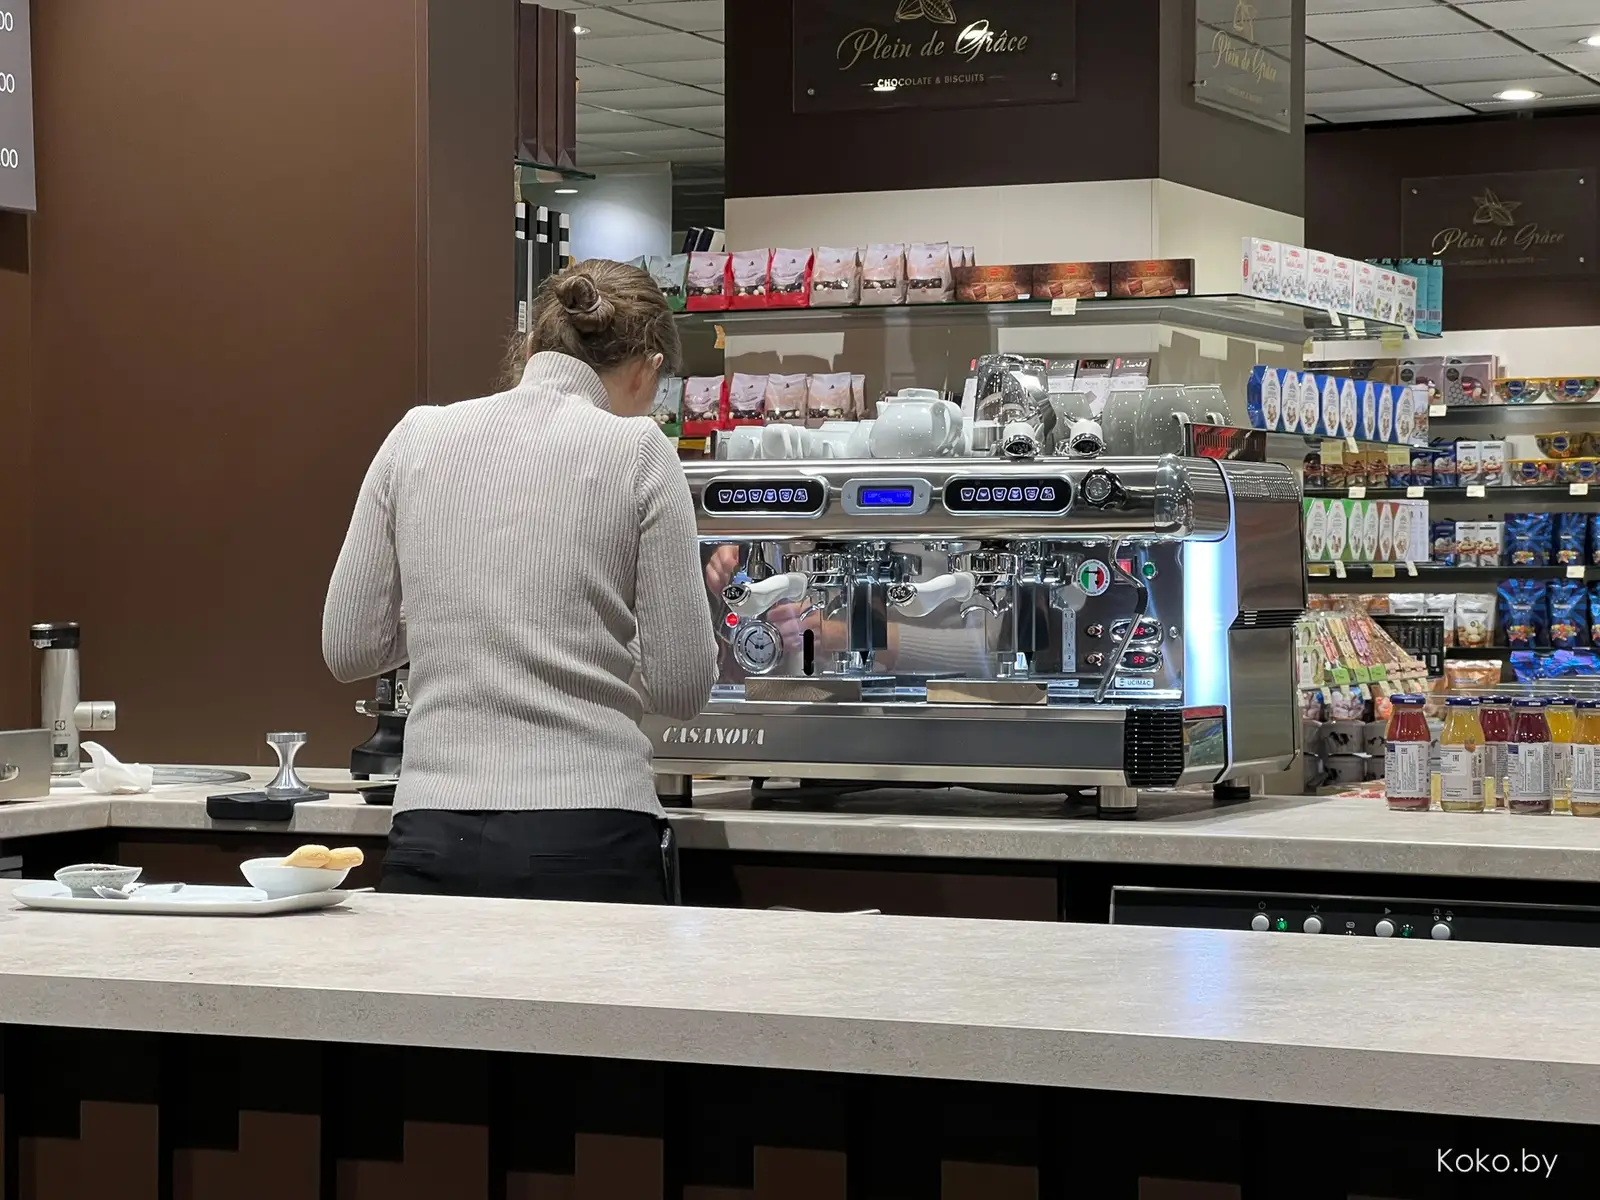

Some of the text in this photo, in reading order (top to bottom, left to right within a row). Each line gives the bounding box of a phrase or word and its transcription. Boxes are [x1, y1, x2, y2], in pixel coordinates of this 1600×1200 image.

[836, 19, 1029, 71] Plein de Grâce
[877, 76, 932, 87] CHOCOLATE
[944, 74, 984, 83] BISCUITS
[1431, 223, 1565, 256] Plein de Grâce
[662, 727, 765, 745] CASANOVA
